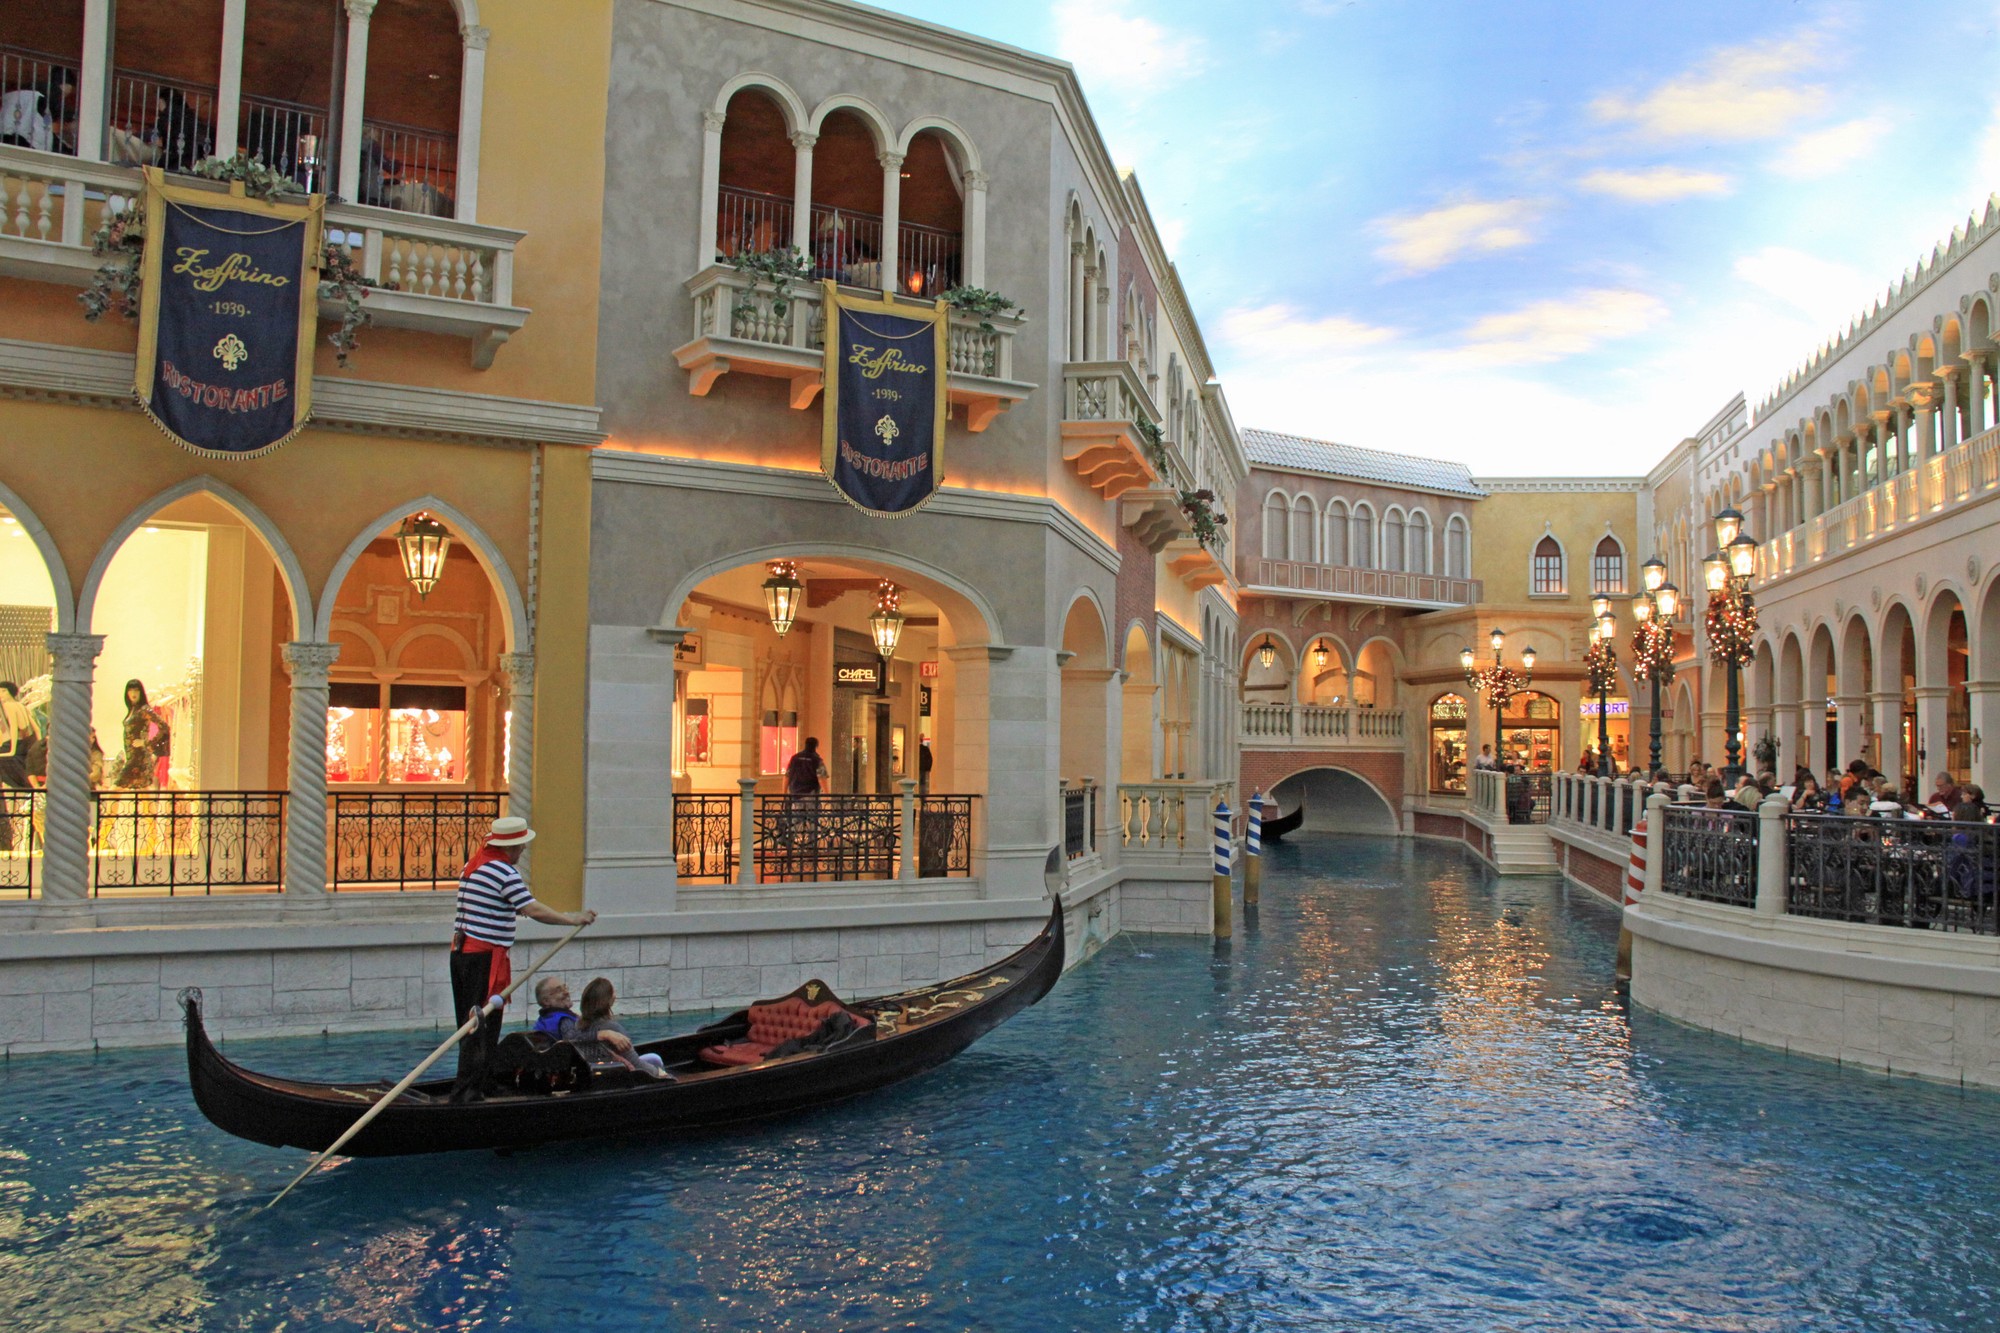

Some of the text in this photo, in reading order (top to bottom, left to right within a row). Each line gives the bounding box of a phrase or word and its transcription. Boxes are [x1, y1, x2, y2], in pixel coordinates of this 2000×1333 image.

[172, 247, 290, 292] Zeffirino
[848, 343, 928, 379] Zeffirino
[162, 360, 288, 413] RISTORANTE
[841, 440, 928, 482] RISTORANTE
[838, 668, 876, 679] CHAPEL
